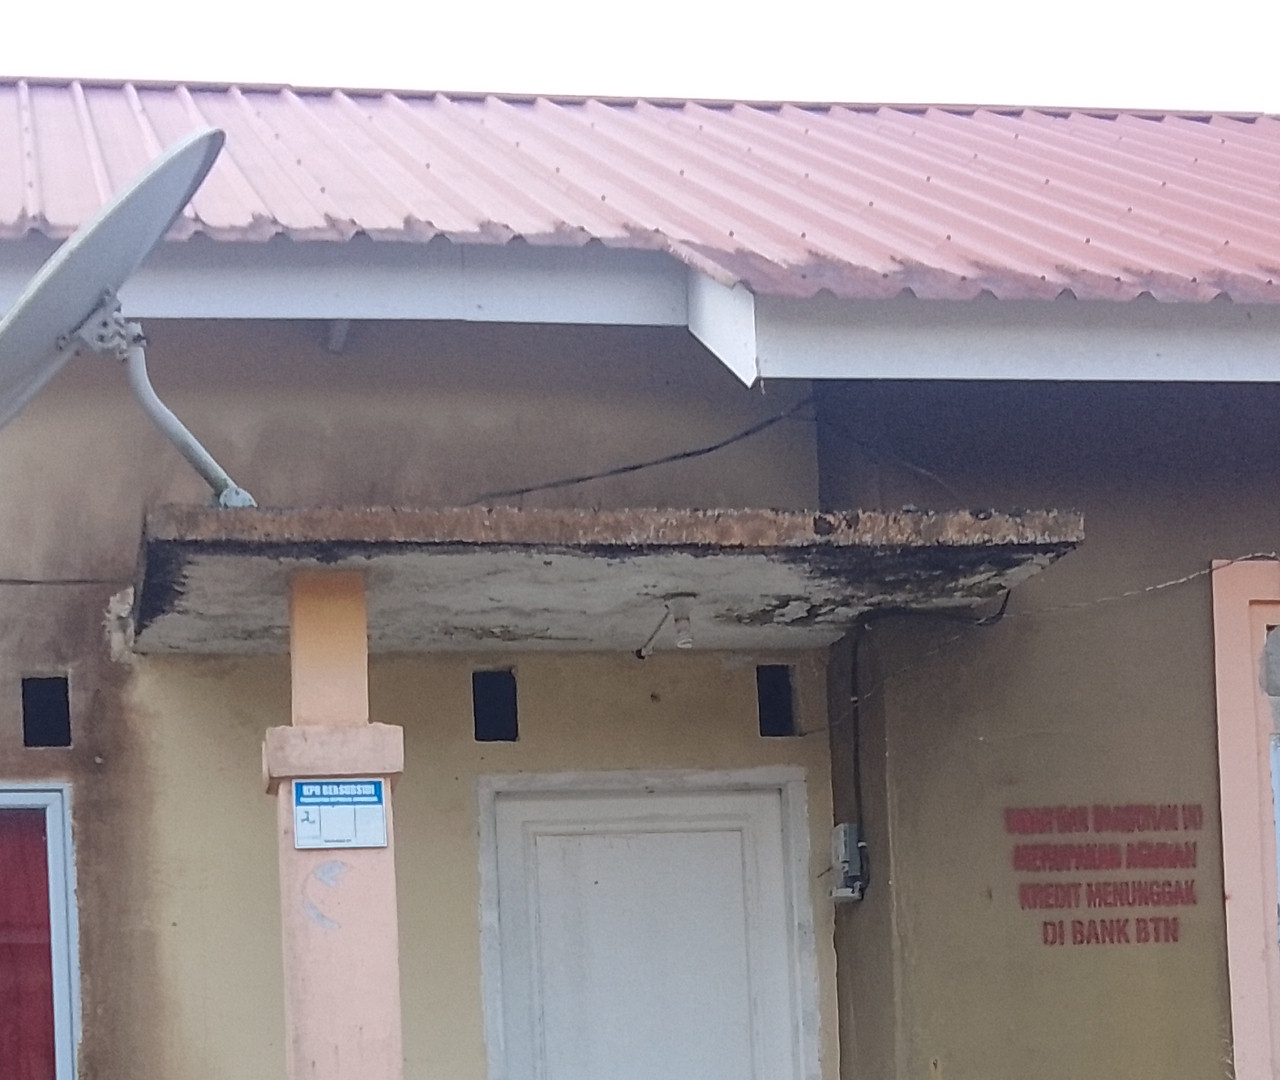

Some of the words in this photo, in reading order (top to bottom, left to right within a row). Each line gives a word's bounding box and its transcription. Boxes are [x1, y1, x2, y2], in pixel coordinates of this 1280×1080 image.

[1019, 882, 1082, 910] KREDIT
[1086, 880, 1197, 909] MENUNGGAK
[1043, 920, 1065, 946] DI
[1072, 918, 1130, 945] BANK
[1135, 917, 1179, 944] BTN
